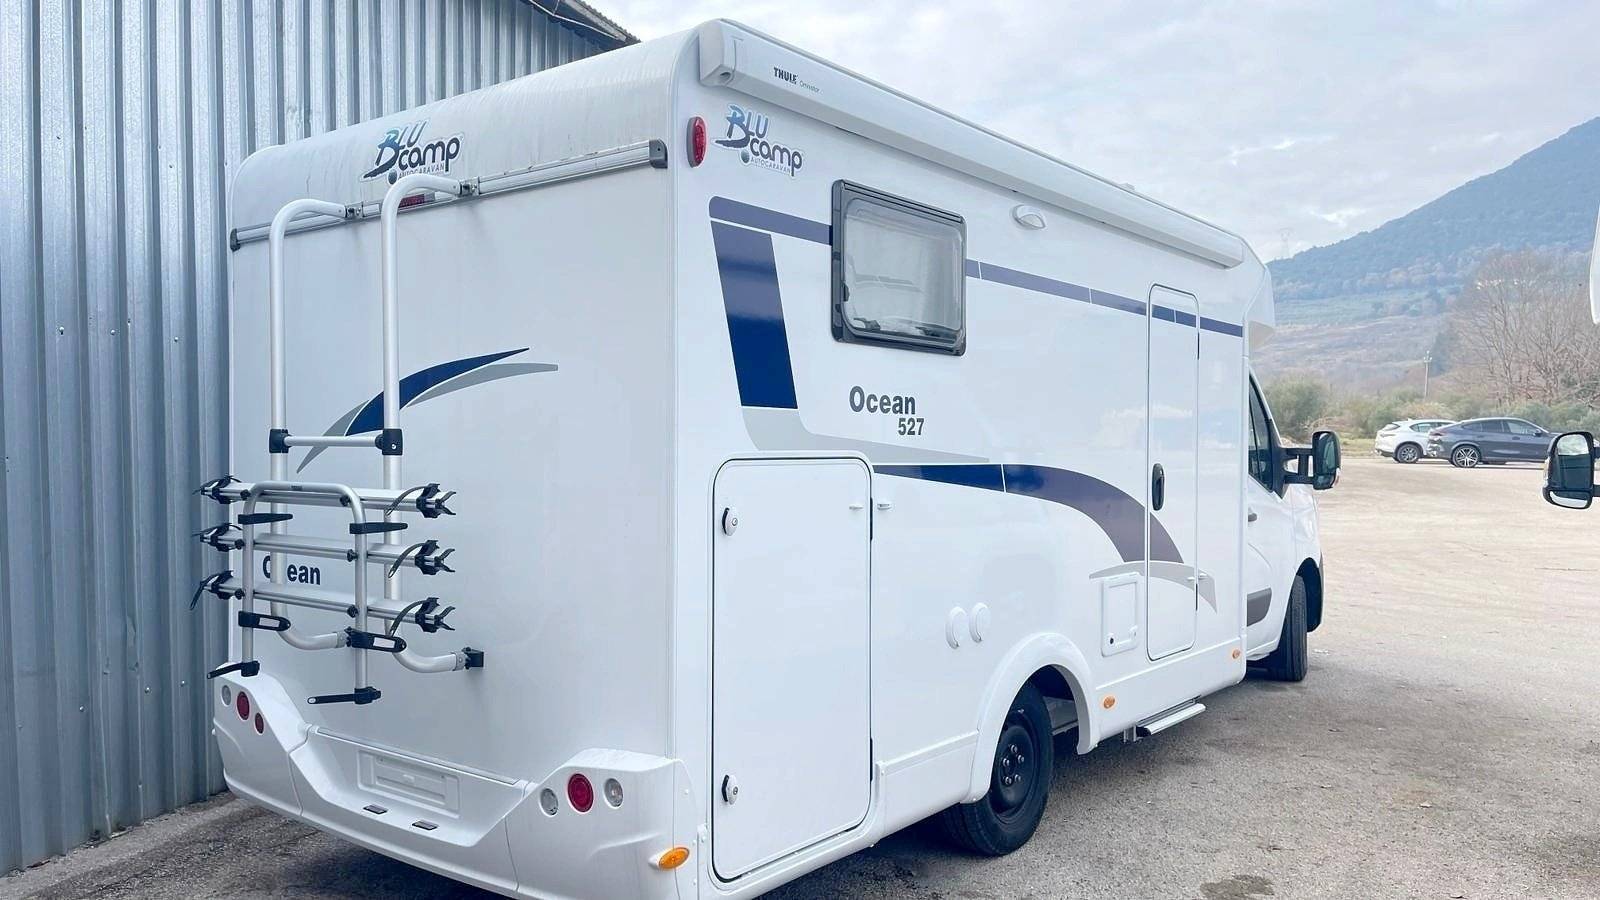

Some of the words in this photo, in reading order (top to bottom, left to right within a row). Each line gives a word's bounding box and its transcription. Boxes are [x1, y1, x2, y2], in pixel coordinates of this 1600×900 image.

[773, 66, 797, 84] THULE
[399, 137, 460, 172] camp
[750, 138, 802, 176] camp
[849, 386, 916, 415] Ocean
[898, 417, 925, 436] 527
[262, 555, 321, 585] Oean
